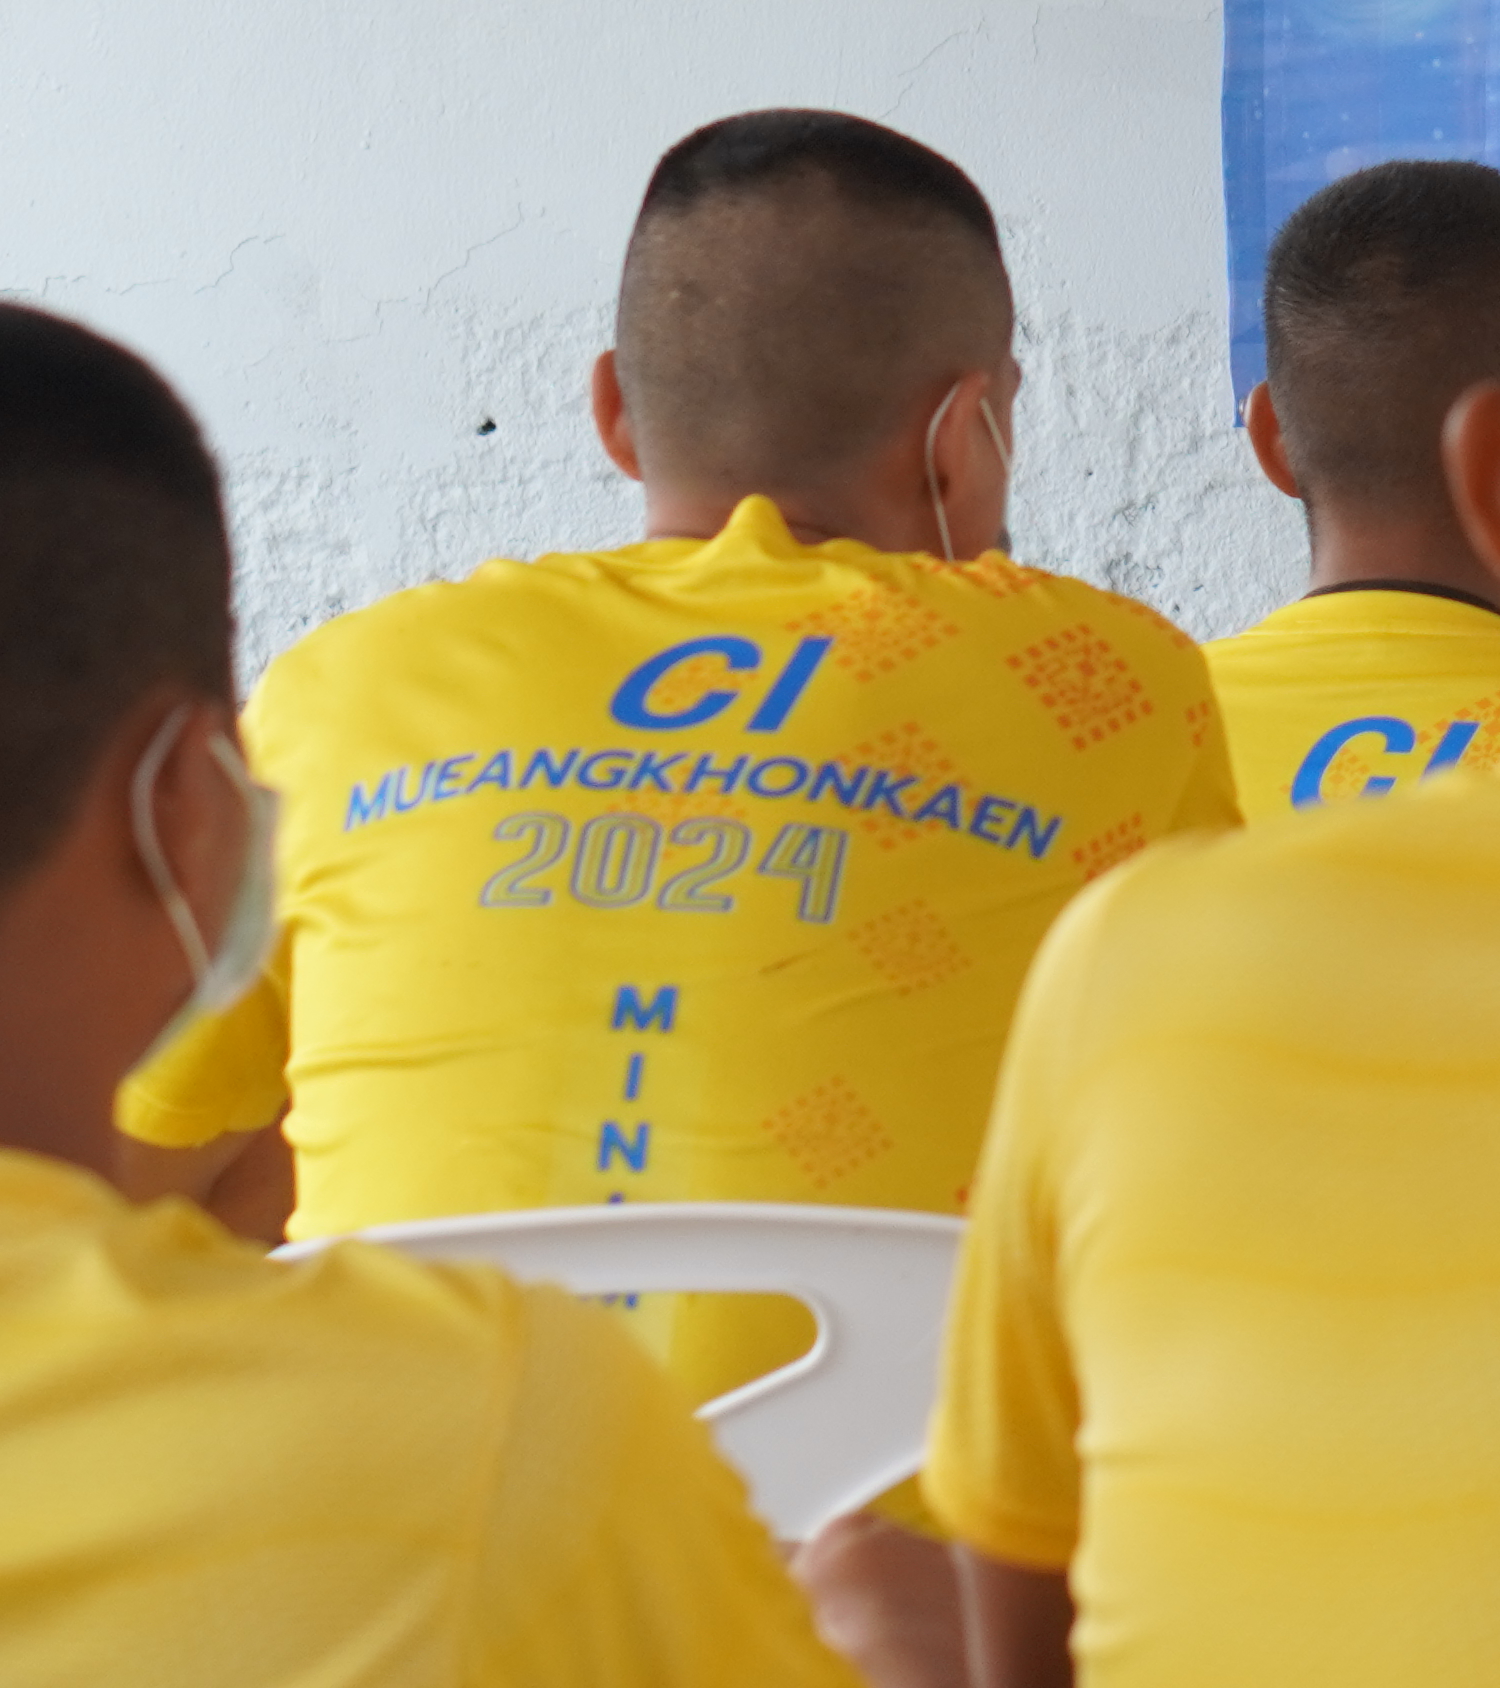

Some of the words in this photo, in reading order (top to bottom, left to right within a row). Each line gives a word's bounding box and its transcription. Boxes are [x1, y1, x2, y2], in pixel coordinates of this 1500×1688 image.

[608, 635, 834, 733] CI
[343, 748, 1062, 863] MUEANGKHONKAEN
[1291, 715, 1480, 810] CI
[478, 812, 850, 925] 2024
[597, 983, 679, 1205] MIN
